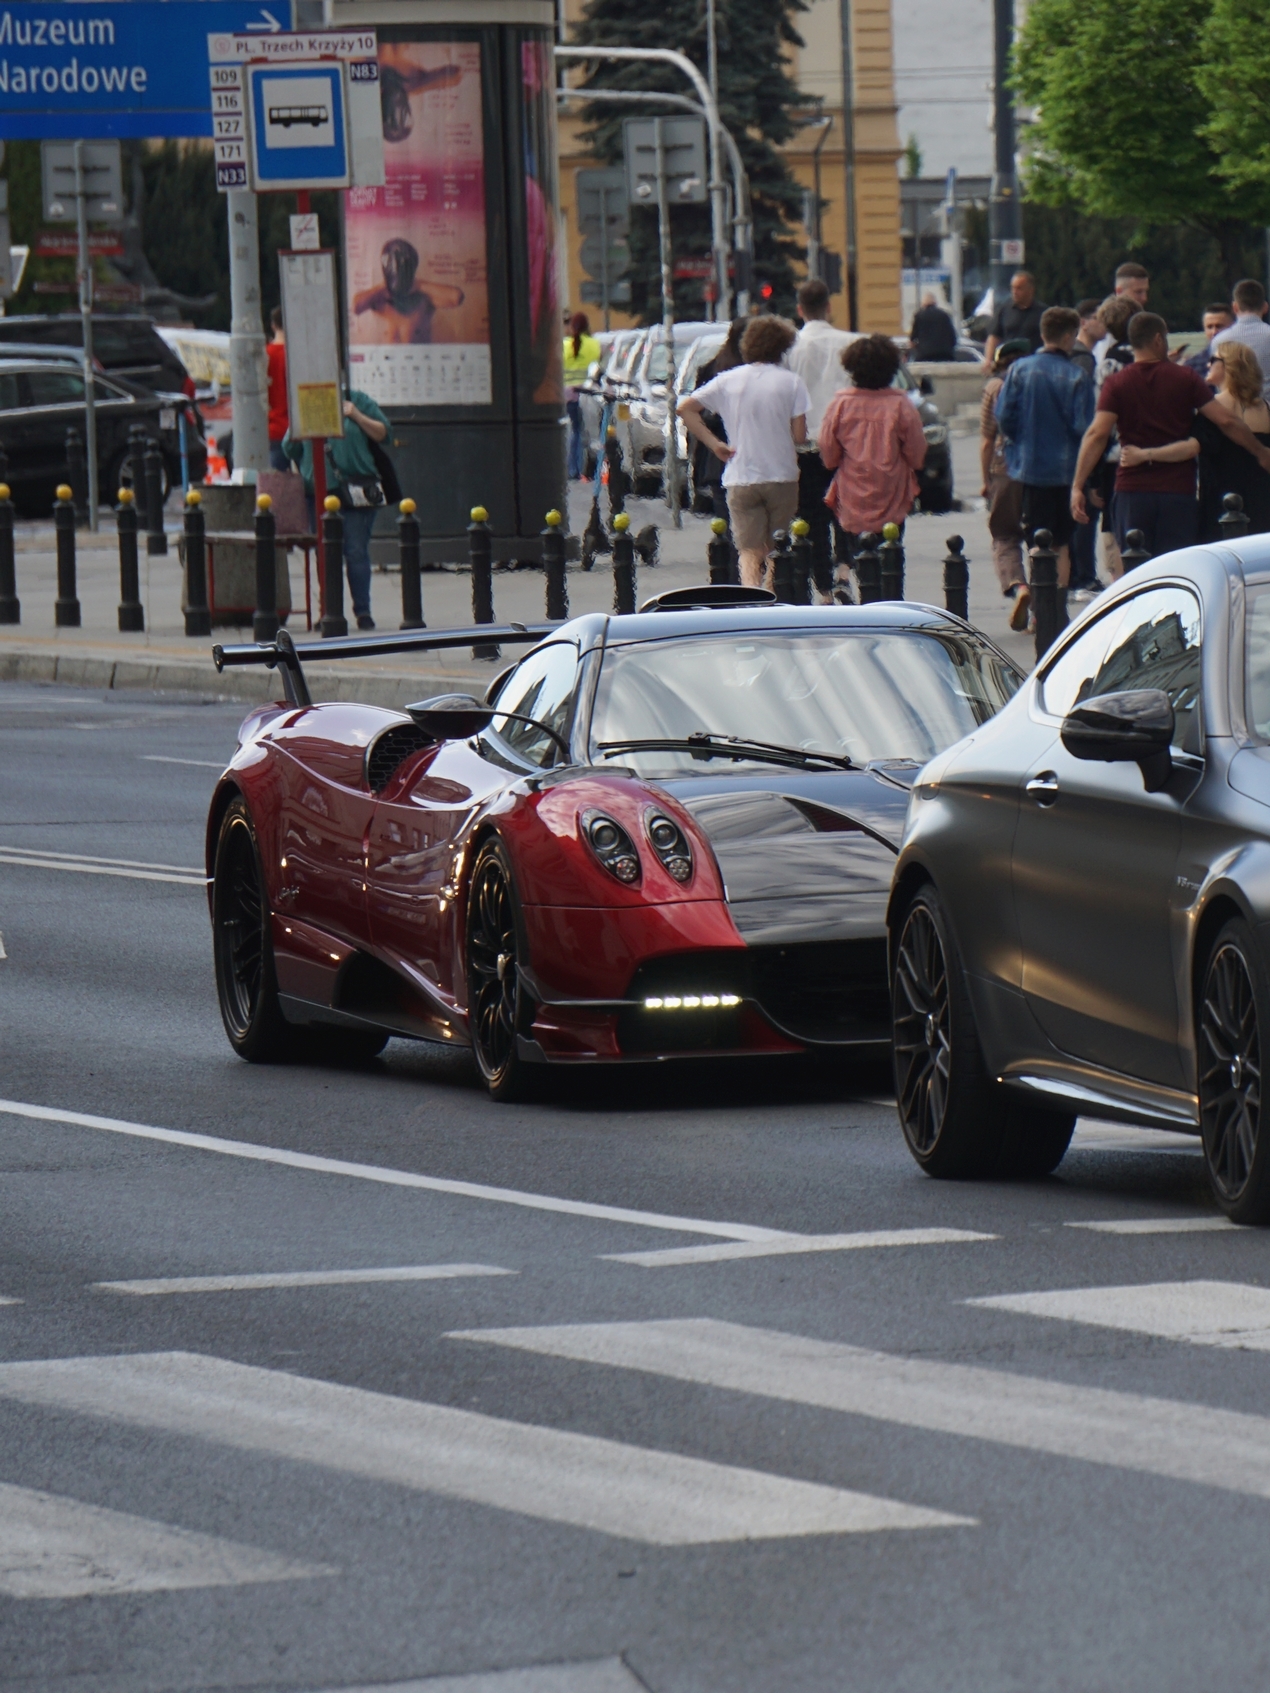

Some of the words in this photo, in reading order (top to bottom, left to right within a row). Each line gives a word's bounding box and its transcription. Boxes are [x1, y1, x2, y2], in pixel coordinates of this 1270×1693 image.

[261, 37, 304, 53] Trzech
[309, 36, 356, 53] Krzyży
[357, 37, 374, 50] 10
[214, 69, 237, 84] 109
[351, 63, 378, 79] N83
[216, 94, 238, 109] 116
[217, 120, 240, 134] 127
[219, 145, 241, 158] 171
[218, 168, 245, 184] N33
